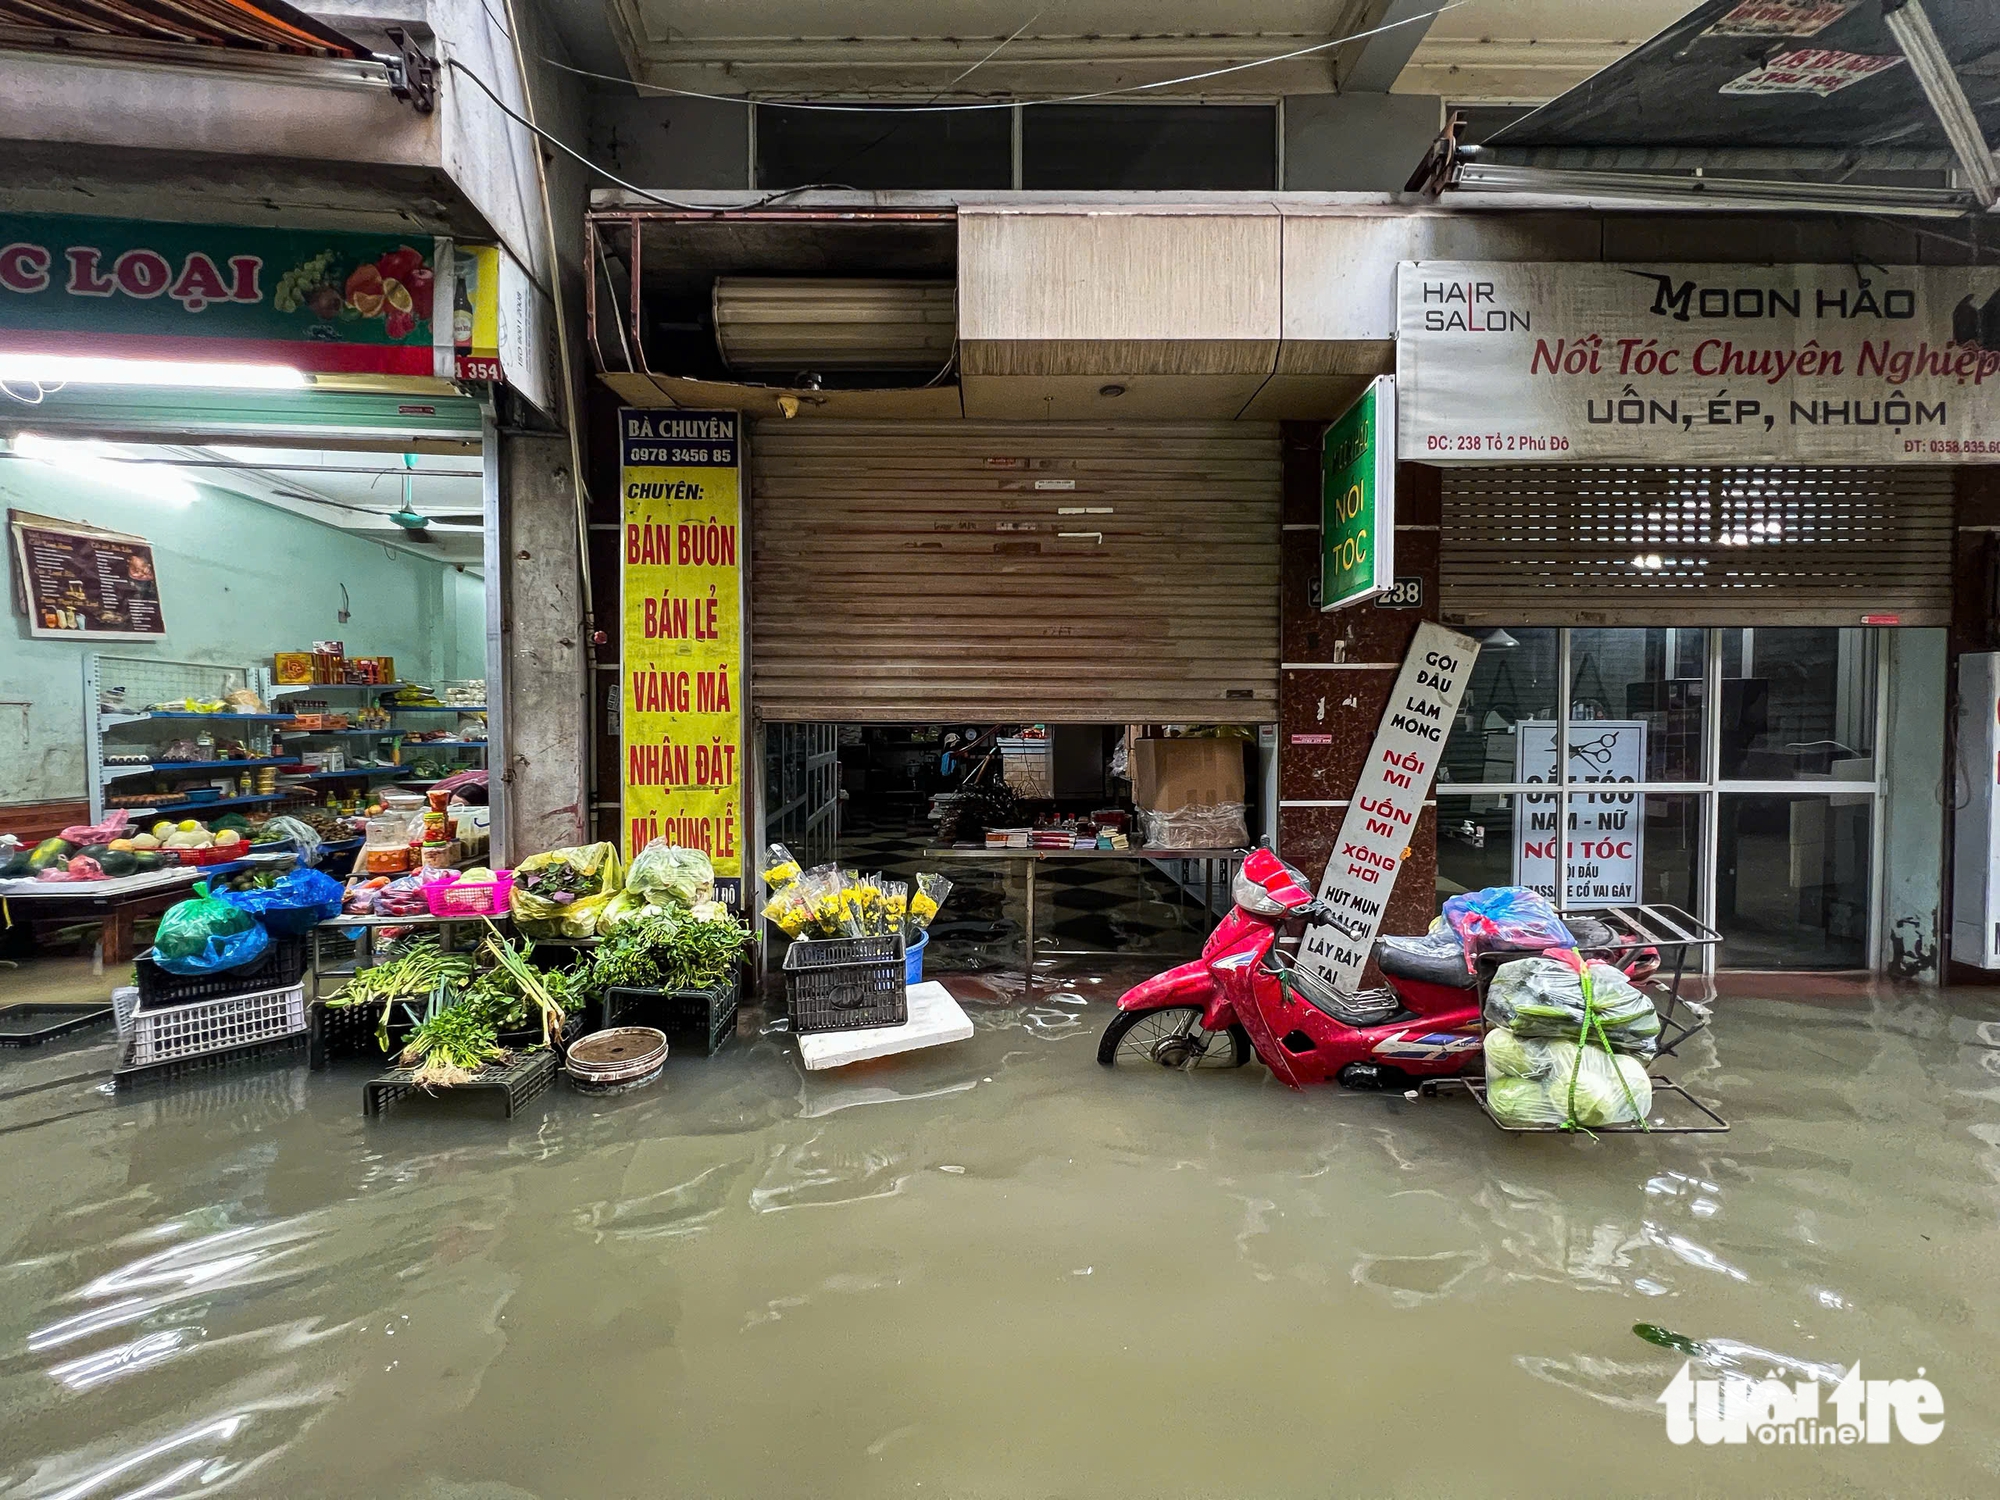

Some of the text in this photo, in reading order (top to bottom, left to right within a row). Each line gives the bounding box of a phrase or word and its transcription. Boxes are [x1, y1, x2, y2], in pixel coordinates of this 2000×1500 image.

[65, 246, 263, 313] LOẠI
[1423, 282, 1496, 303] HAIR
[1630, 276, 1800, 322] MOON
[1425, 283, 1531, 332] SALON
[468, 364, 499, 379] 354
[1530, 334, 2000, 385] Nối Tóc Chuyên Nghiệp
[1588, 384, 1946, 435] UỐN, ÉP, NHUỘM
[628, 416, 734, 442] BÀ CHUYỆN
[1427, 432, 1569, 450] ĐC: 238 Tổ 2 Phú Đô
[630, 448, 731, 462] 0978 3456 85
[1904, 440, 1926, 453] ĐT:
[627, 480, 704, 500] CHUYÊN:
[627, 515, 735, 566] BÁN BUÔN
[644, 584, 718, 639] BÁN LẺ
[633, 663, 690, 713] VÀNG
[697, 664, 731, 713] MÃ
[630, 736, 735, 794] NHẬN ĐẶT
[1382, 750, 1425, 775] NỐI
[1383, 769, 1411, 789] MI
[1360, 796, 1412, 825] UỐN
[1598, 809, 1628, 831] NỮ
[715, 802, 734, 858] LỄ
[1366, 818, 1394, 838] MI
[1342, 843, 1396, 871] XÔNG
[1580, 837, 1632, 859] TÓC
[1347, 863, 1380, 884] HƠI
[1593, 885, 1609, 897] VAI
